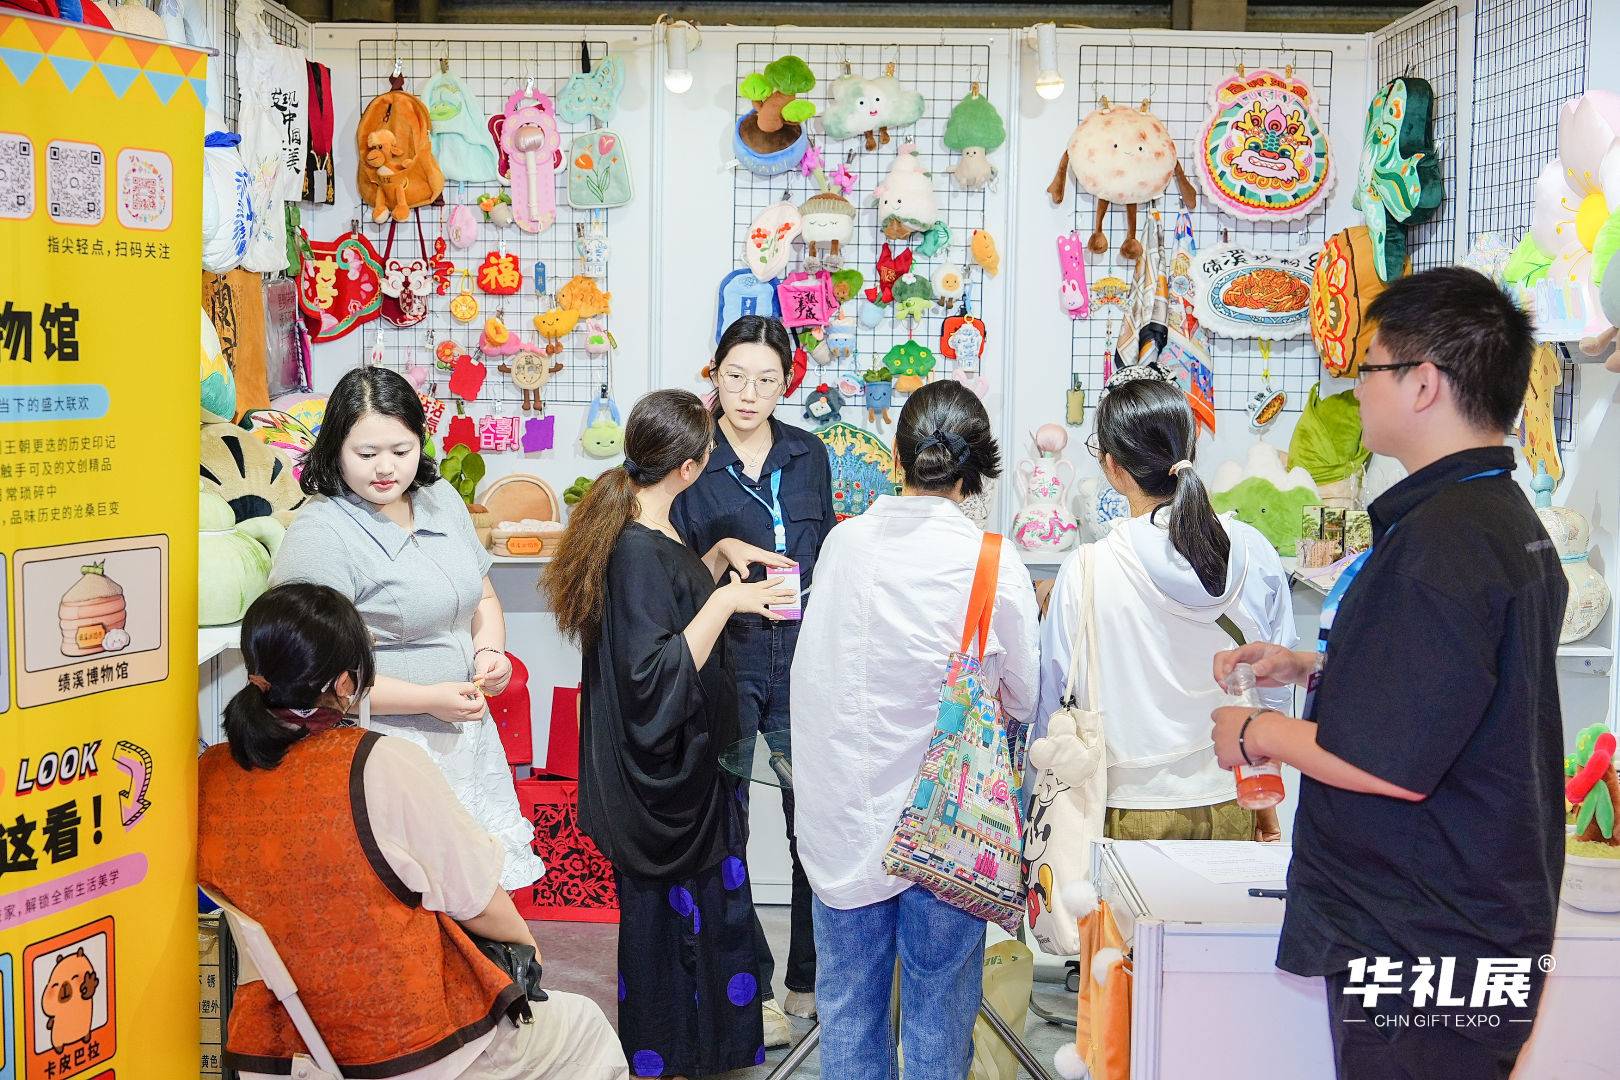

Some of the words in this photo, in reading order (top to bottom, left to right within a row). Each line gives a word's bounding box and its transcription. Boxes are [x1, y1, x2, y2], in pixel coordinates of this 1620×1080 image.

[48, 235, 171, 261] 指尖轻点，扫码关注
[482, 258, 520, 290] 福
[0, 301, 79, 363] 物馆
[0, 434, 117, 455] 王朝更迭的历史印记
[58, 661, 129, 692] 绩溪博物馆
[16, 739, 103, 797] LOOK
[0, 869, 120, 920] 家，解锁全新生活美学
[44, 1040, 101, 1080] 卡皮巴拉
[201, 1054, 222, 1070] 黄色
